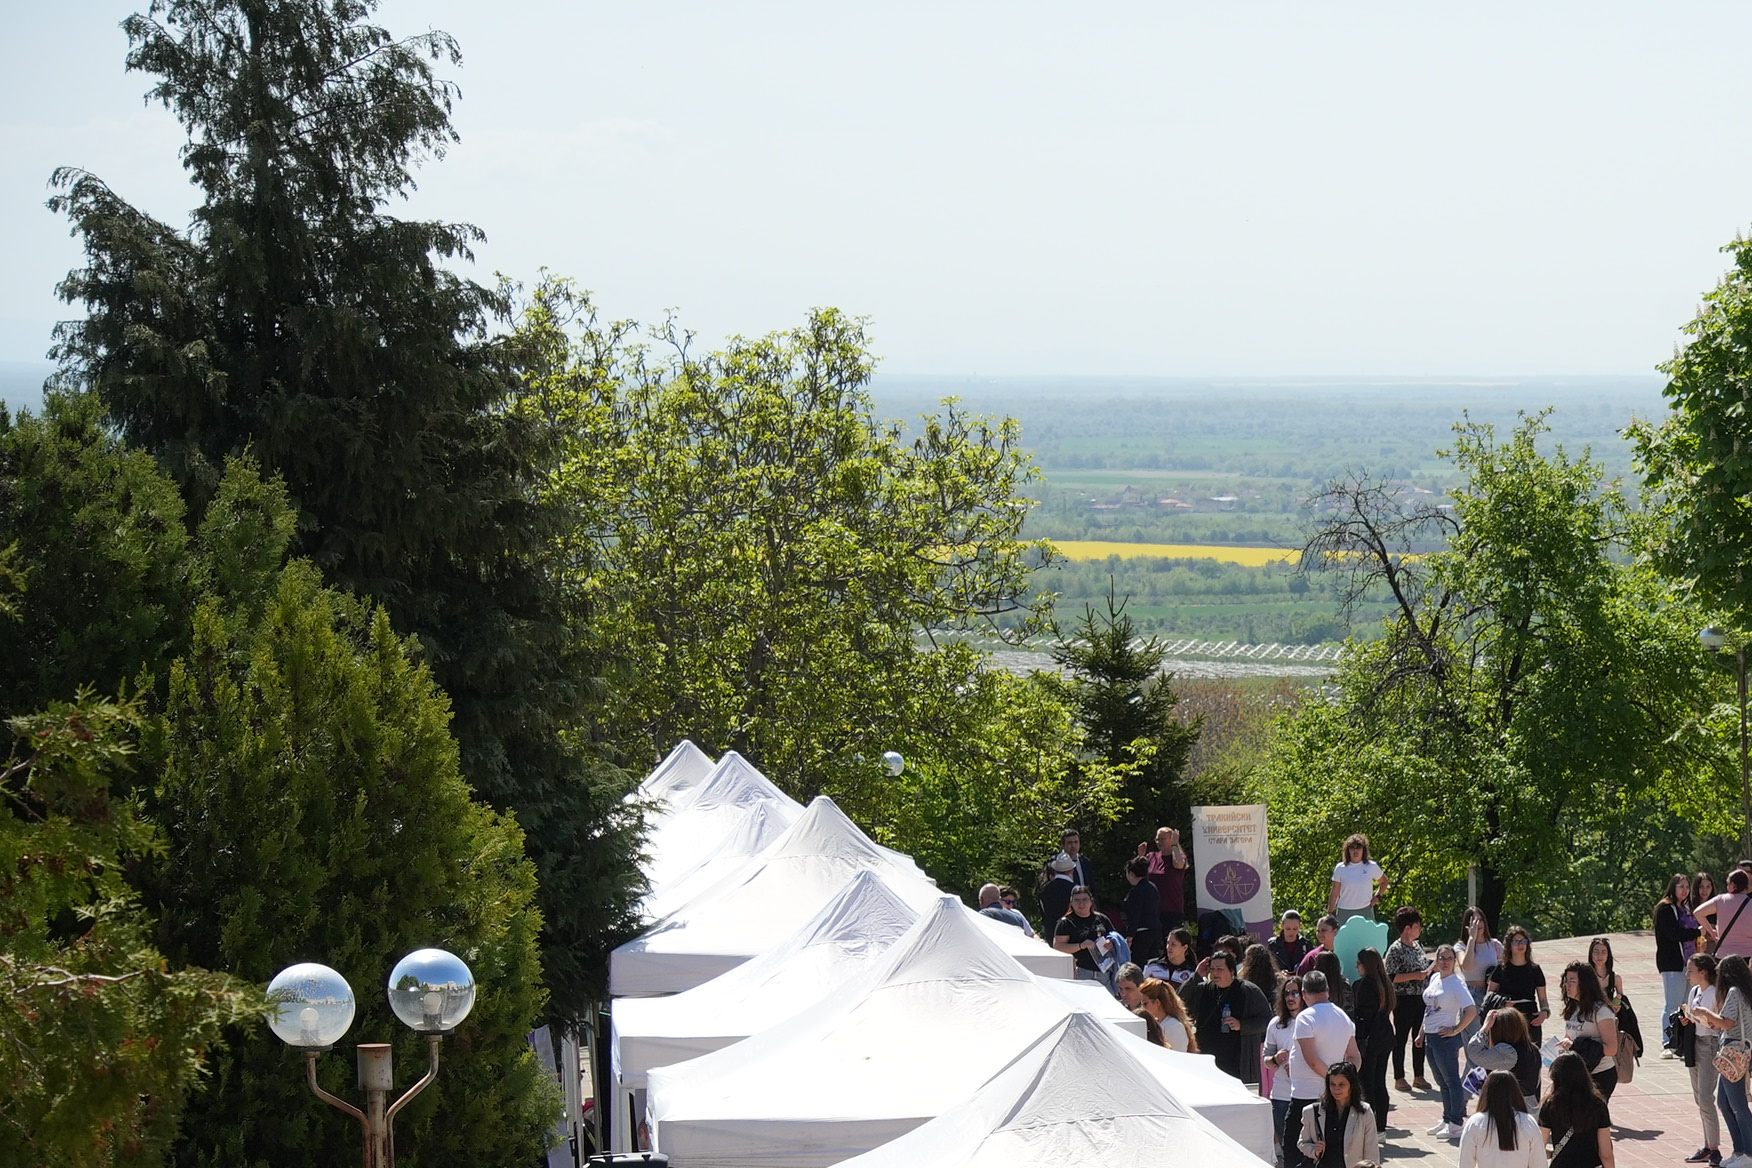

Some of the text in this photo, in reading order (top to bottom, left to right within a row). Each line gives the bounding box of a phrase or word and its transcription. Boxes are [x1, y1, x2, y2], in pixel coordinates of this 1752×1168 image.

[1206, 811, 1251, 822] ТРАКИЙСКИ
[1202, 824, 1257, 834] УНИВЕРСИТЕТ
[1229, 836, 1253, 844] ЗАГОРА
